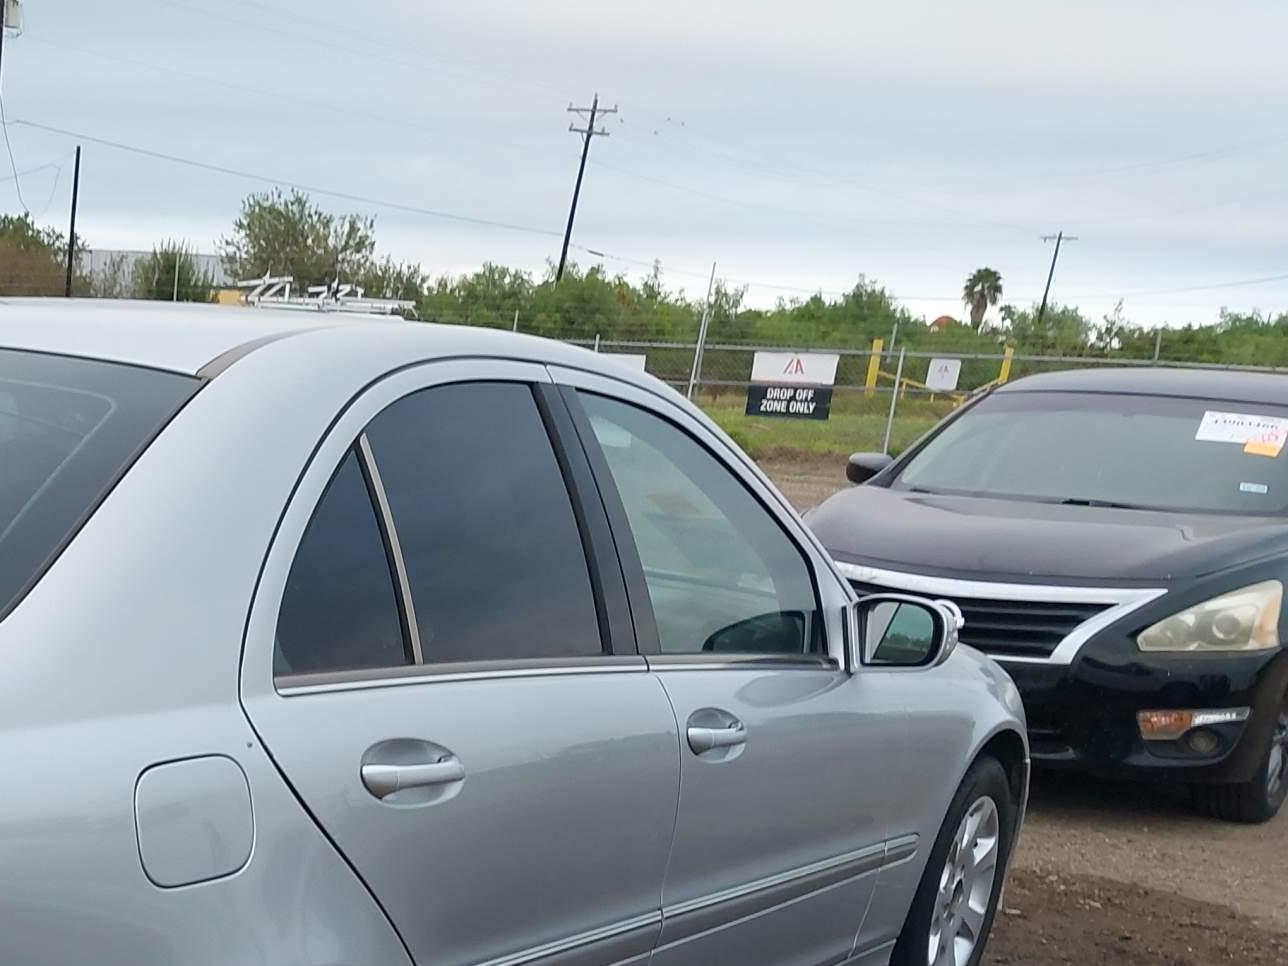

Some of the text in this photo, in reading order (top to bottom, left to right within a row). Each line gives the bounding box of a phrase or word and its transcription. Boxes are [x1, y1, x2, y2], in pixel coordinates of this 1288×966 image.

[766, 387, 814, 402] DROP OFF
[760, 399, 816, 414] ZONE ONLY
